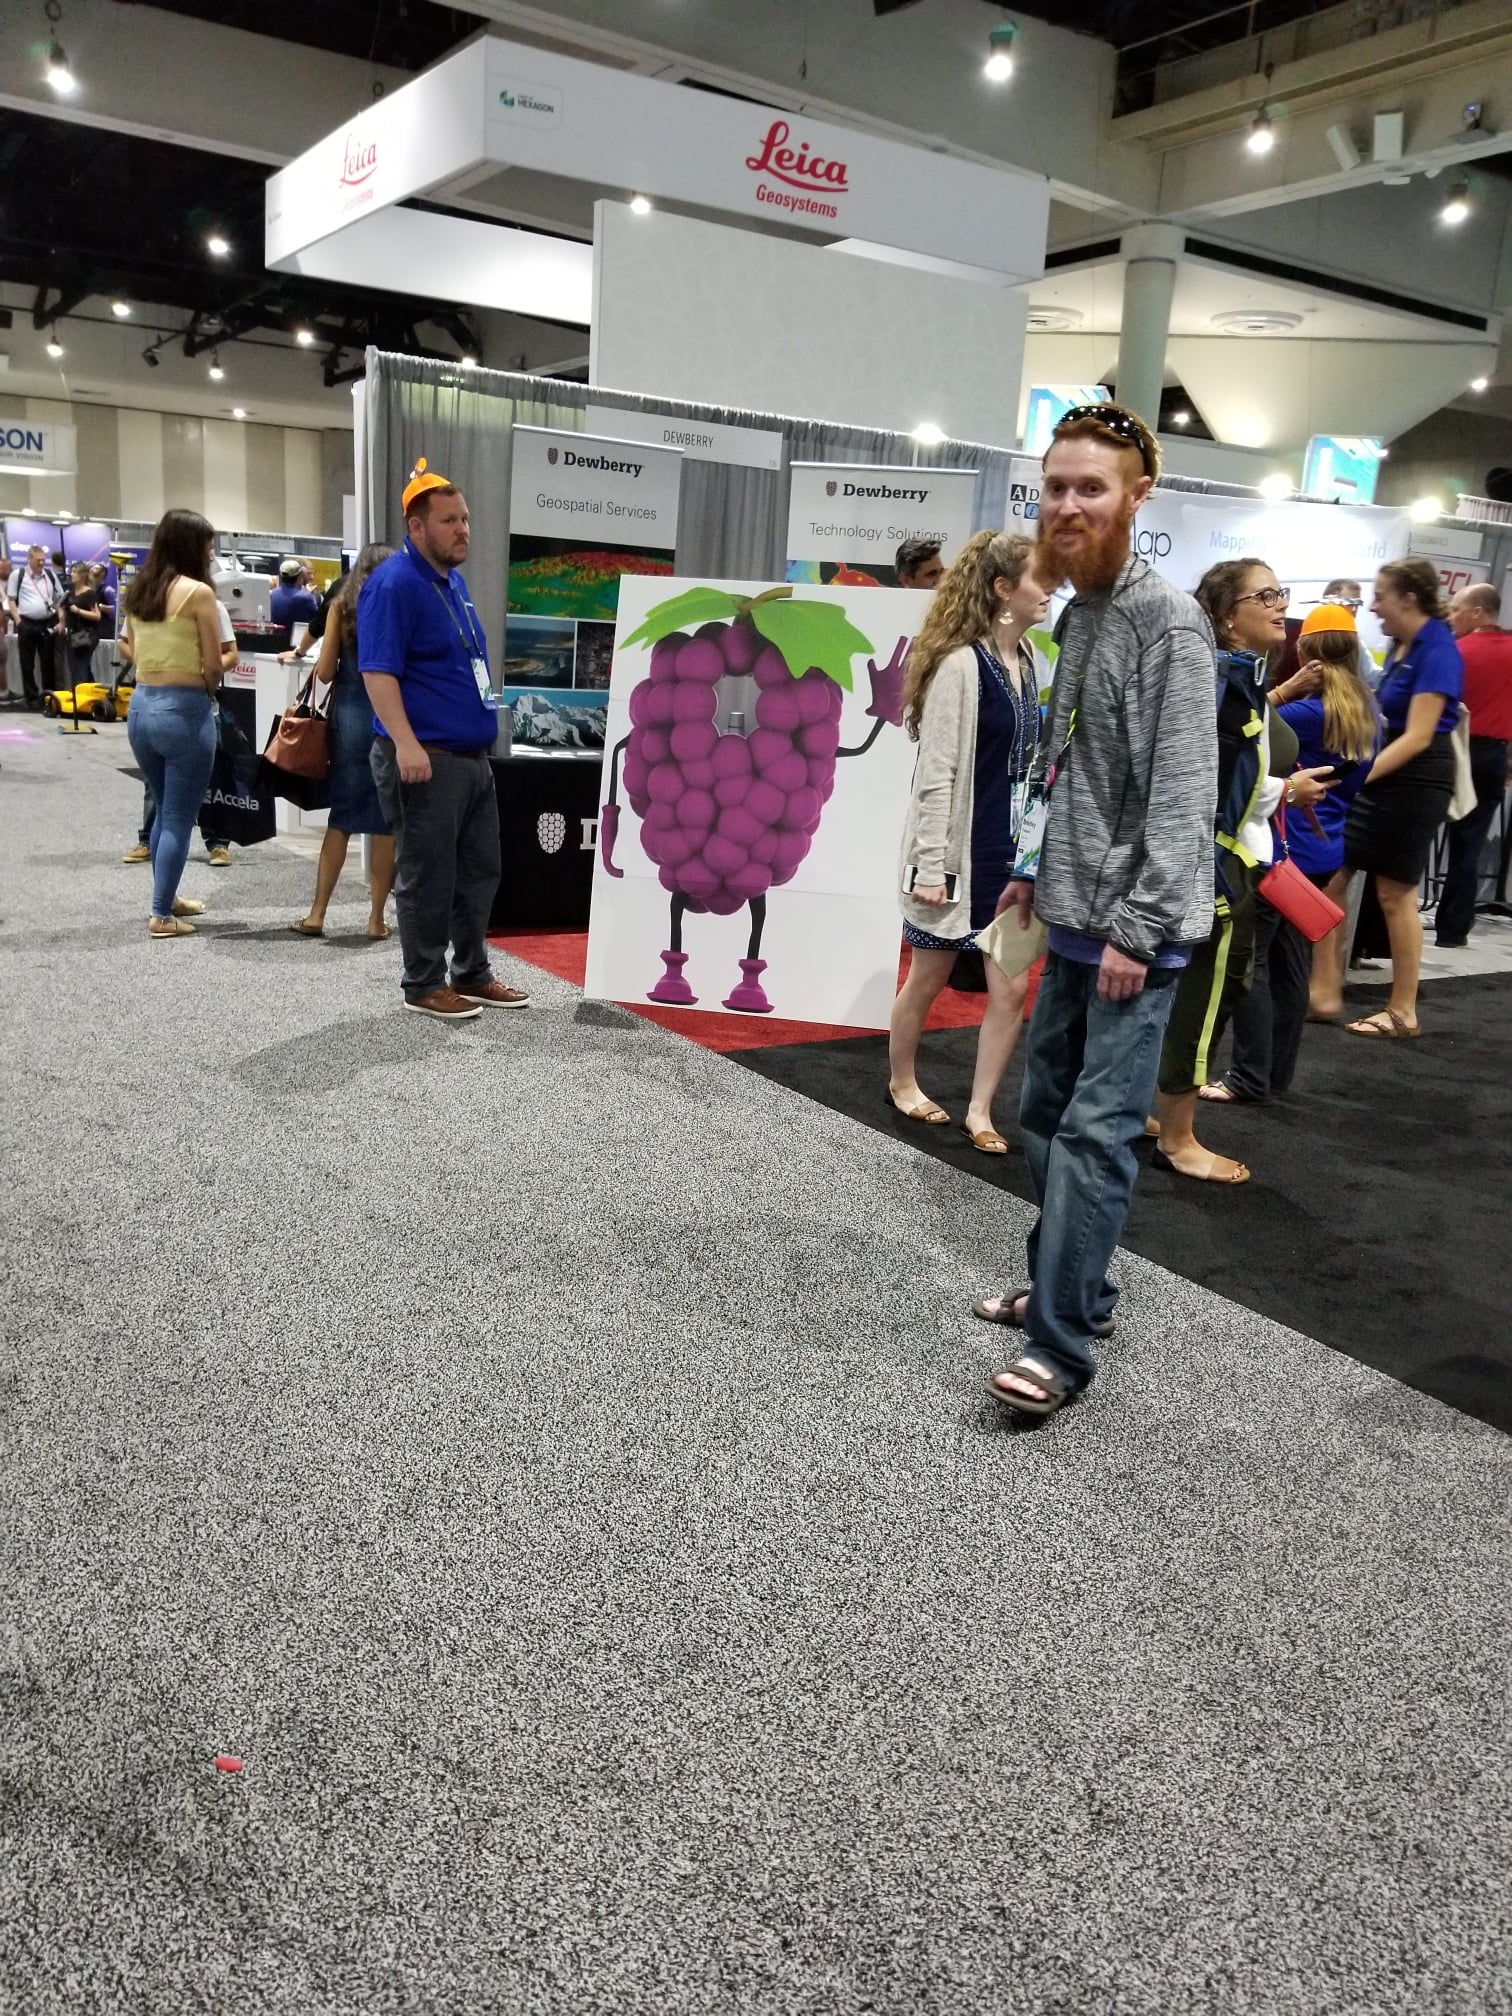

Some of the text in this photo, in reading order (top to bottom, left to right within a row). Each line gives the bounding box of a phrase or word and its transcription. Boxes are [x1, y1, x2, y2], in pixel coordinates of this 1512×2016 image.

[517, 99, 554, 113] HEXAGON
[339, 133, 377, 188] Leica
[745, 121, 848, 191] Leica
[756, 184, 837, 218] Geosystems
[663, 430, 714, 448] DEWBERRY
[564, 451, 642, 477] Dewberry
[843, 483, 928, 503] Dewberry
[536, 493, 657, 520] Geospatial Services
[809, 522, 949, 542] Technology Solutions
[213, 789, 259, 811] Accela
